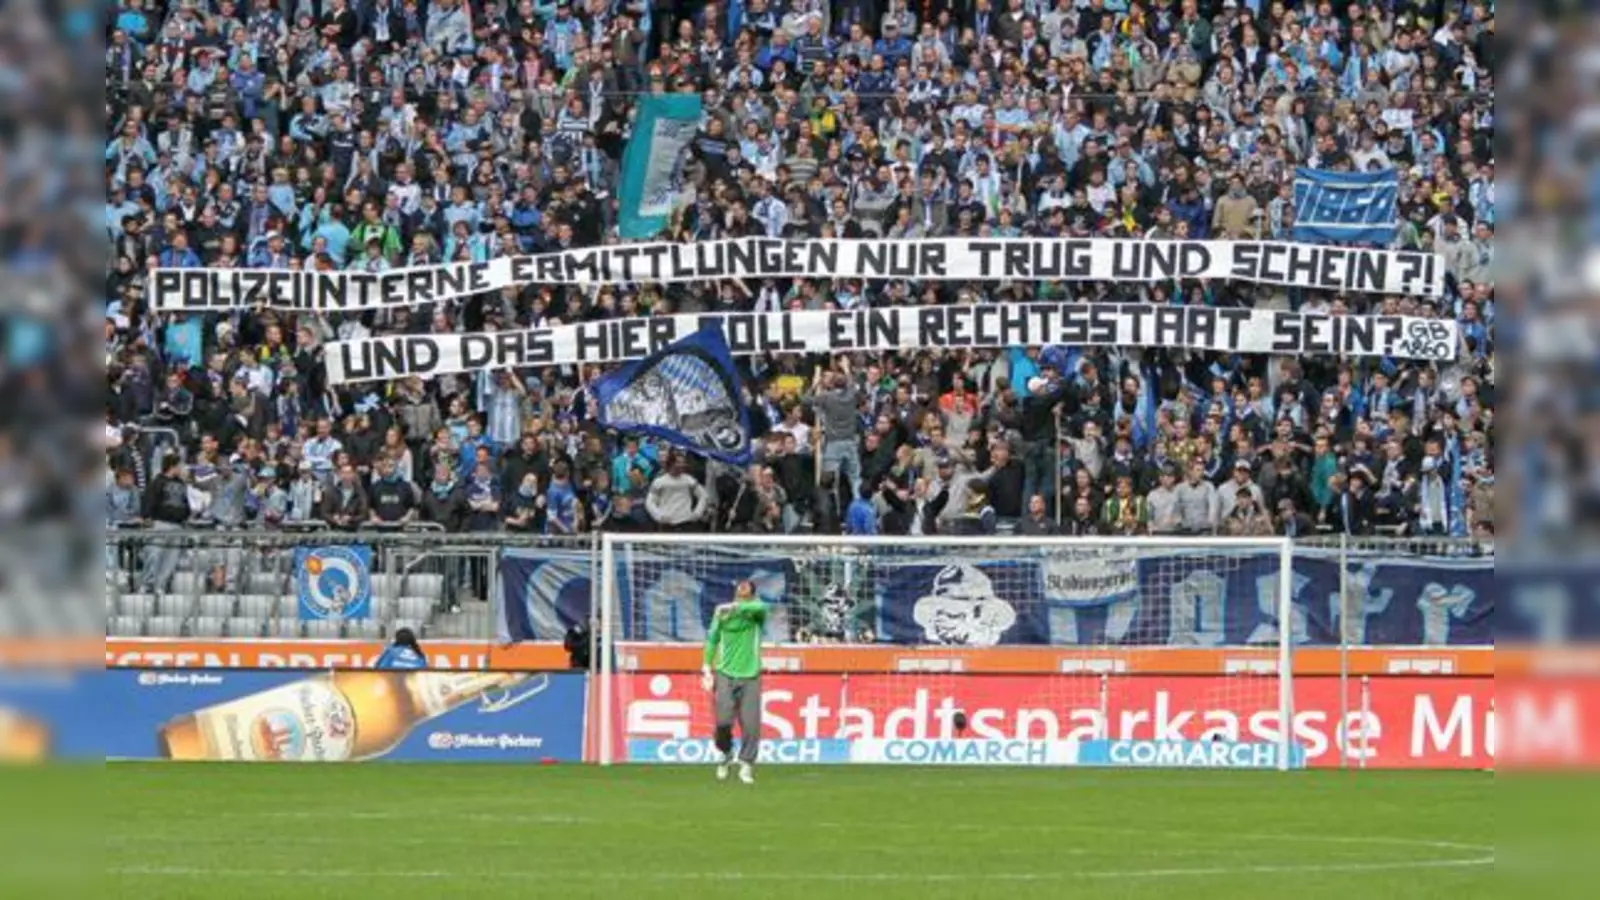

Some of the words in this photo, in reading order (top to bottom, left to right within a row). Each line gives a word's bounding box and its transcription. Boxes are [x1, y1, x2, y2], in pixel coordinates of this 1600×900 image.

[156, 262, 491, 307] POLIZEIINTERNE
[511, 240, 838, 281] ERMITTLUNGEN
[857, 242, 946, 275] NUR
[968, 241, 1092, 276] TRUG
[1112, 241, 1211, 278] UND
[341, 338, 439, 381] UND
[460, 330, 553, 368] DAS
[576, 317, 676, 359] HIER
[698, 314, 806, 350] OLL
[828, 309, 899, 347] EIN
[919, 304, 1250, 348] RECHTSSTAAT
[1273, 312, 1402, 354] SEIN?
[1408, 320, 1449, 340] GB
[884, 740, 1048, 762] COMARCH
[1109, 741, 1275, 766] COMARCH
